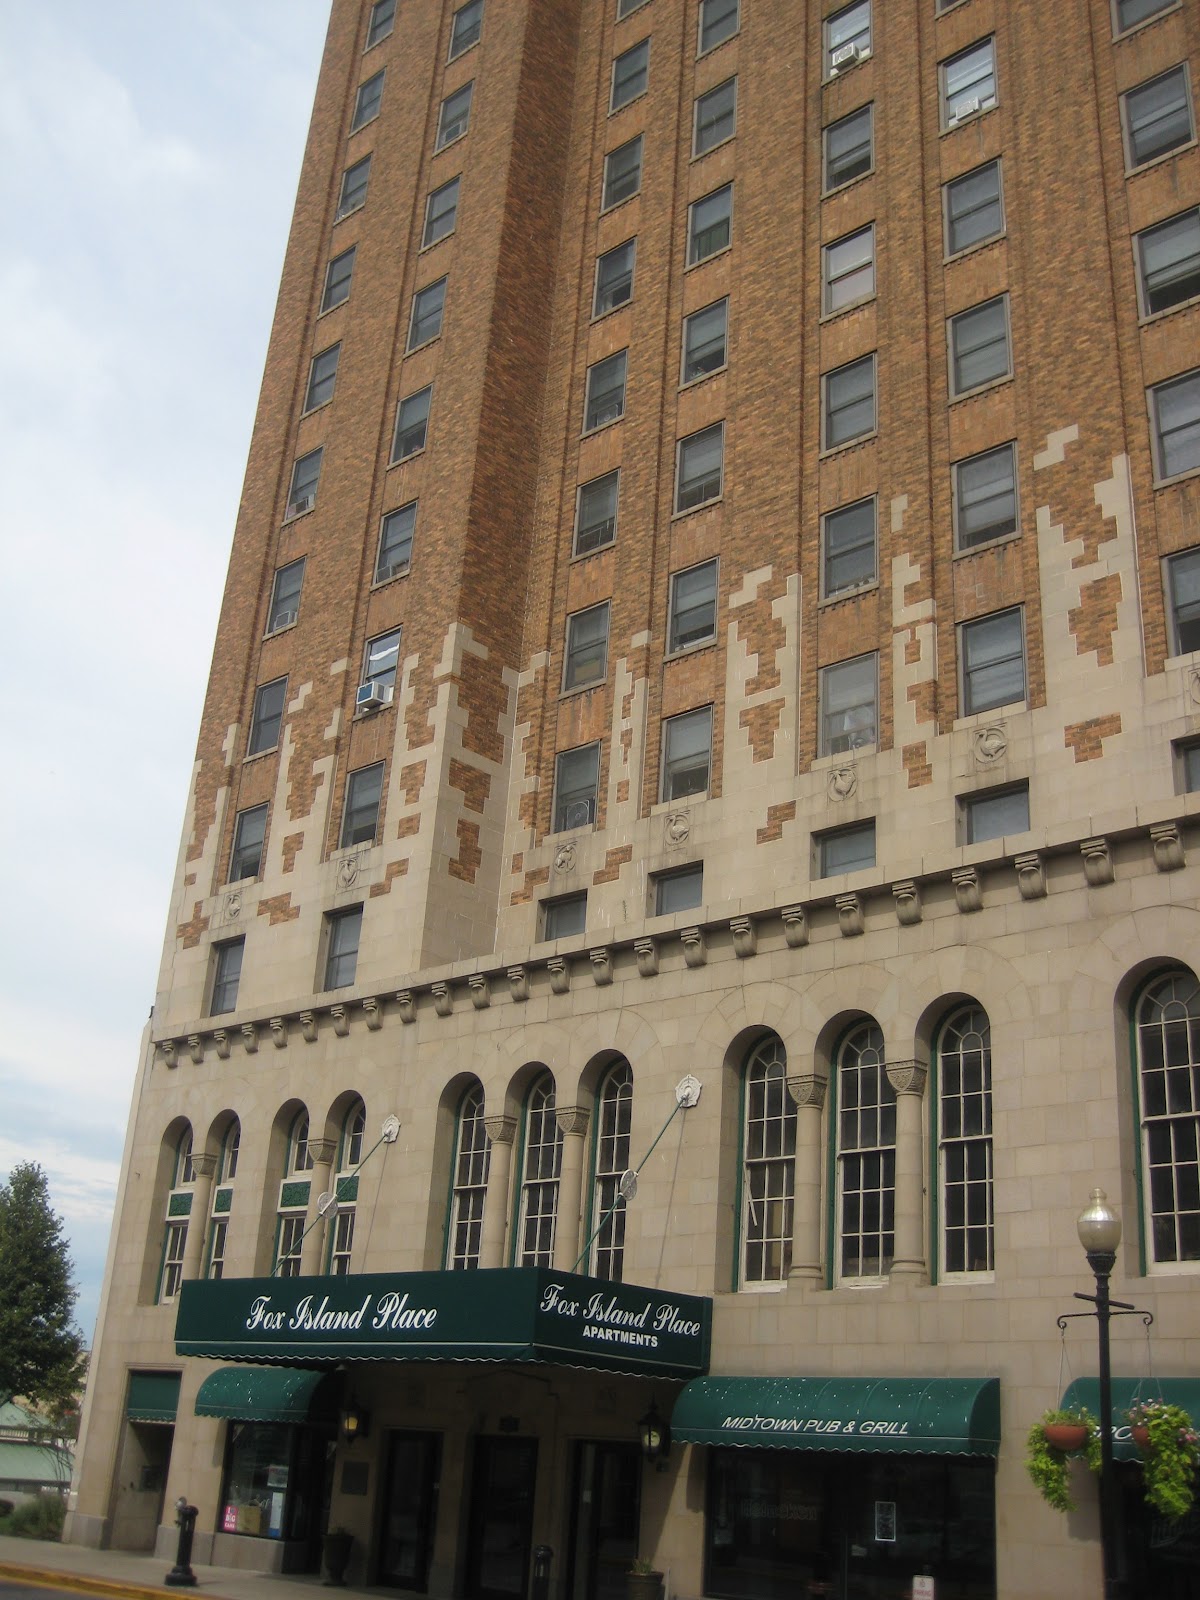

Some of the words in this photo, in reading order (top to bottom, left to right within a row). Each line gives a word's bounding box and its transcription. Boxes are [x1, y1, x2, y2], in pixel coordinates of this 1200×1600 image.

[246, 1295, 285, 1330] Fox
[289, 1294, 372, 1330] Island
[372, 1292, 438, 1329] Place
[540, 1284, 580, 1316] Fox
[583, 1292, 651, 1328] Island
[653, 1304, 701, 1336] Place
[583, 1325, 658, 1347] APARTMENTS
[721, 1416, 803, 1431] MIDTOWN
[803, 1419, 842, 1432] PUB
[842, 1421, 855, 1433] &
[858, 1421, 909, 1434] GRILL
